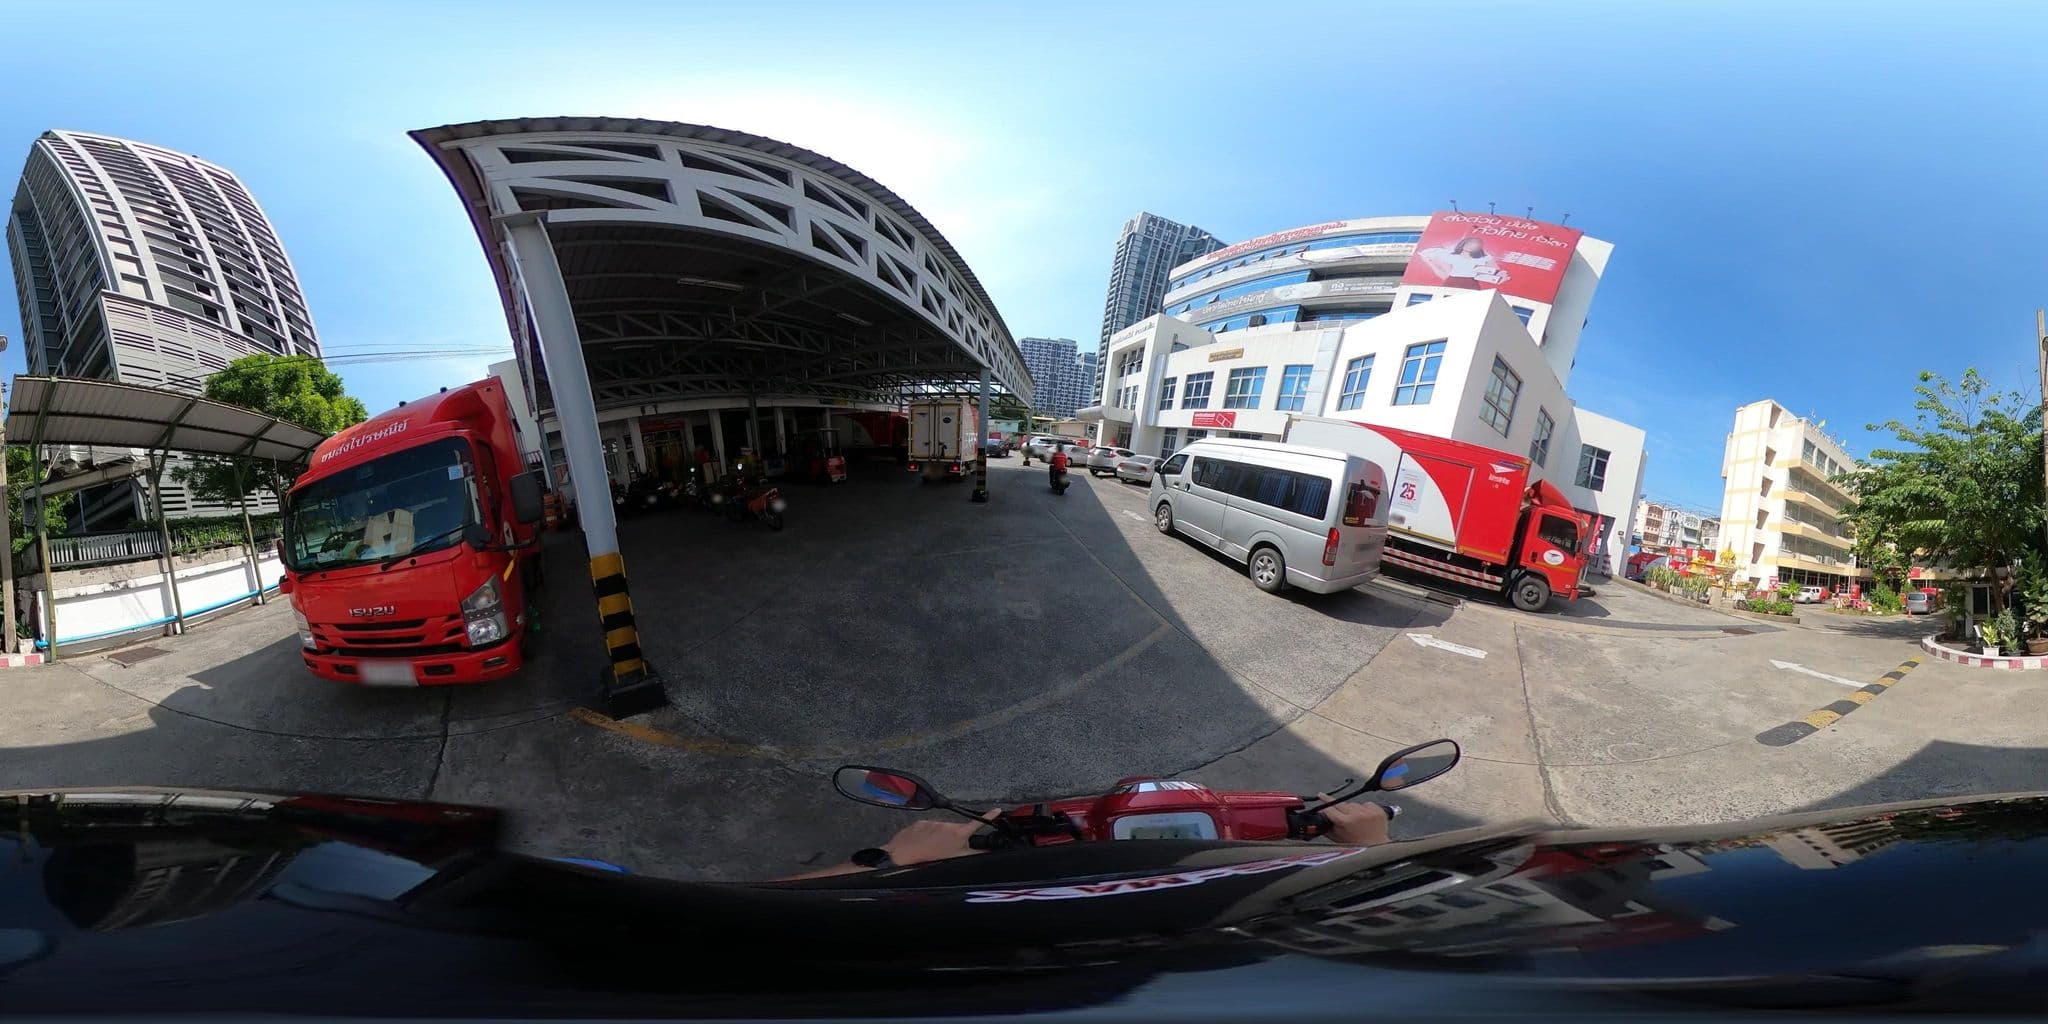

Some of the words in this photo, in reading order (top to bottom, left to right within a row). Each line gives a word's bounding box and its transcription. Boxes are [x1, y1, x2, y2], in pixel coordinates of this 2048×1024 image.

[1443, 213, 1502, 225] ส่งด่วน
[1472, 224, 1528, 239] ทั่วไทย
[348, 605, 395, 617] ISUZU
